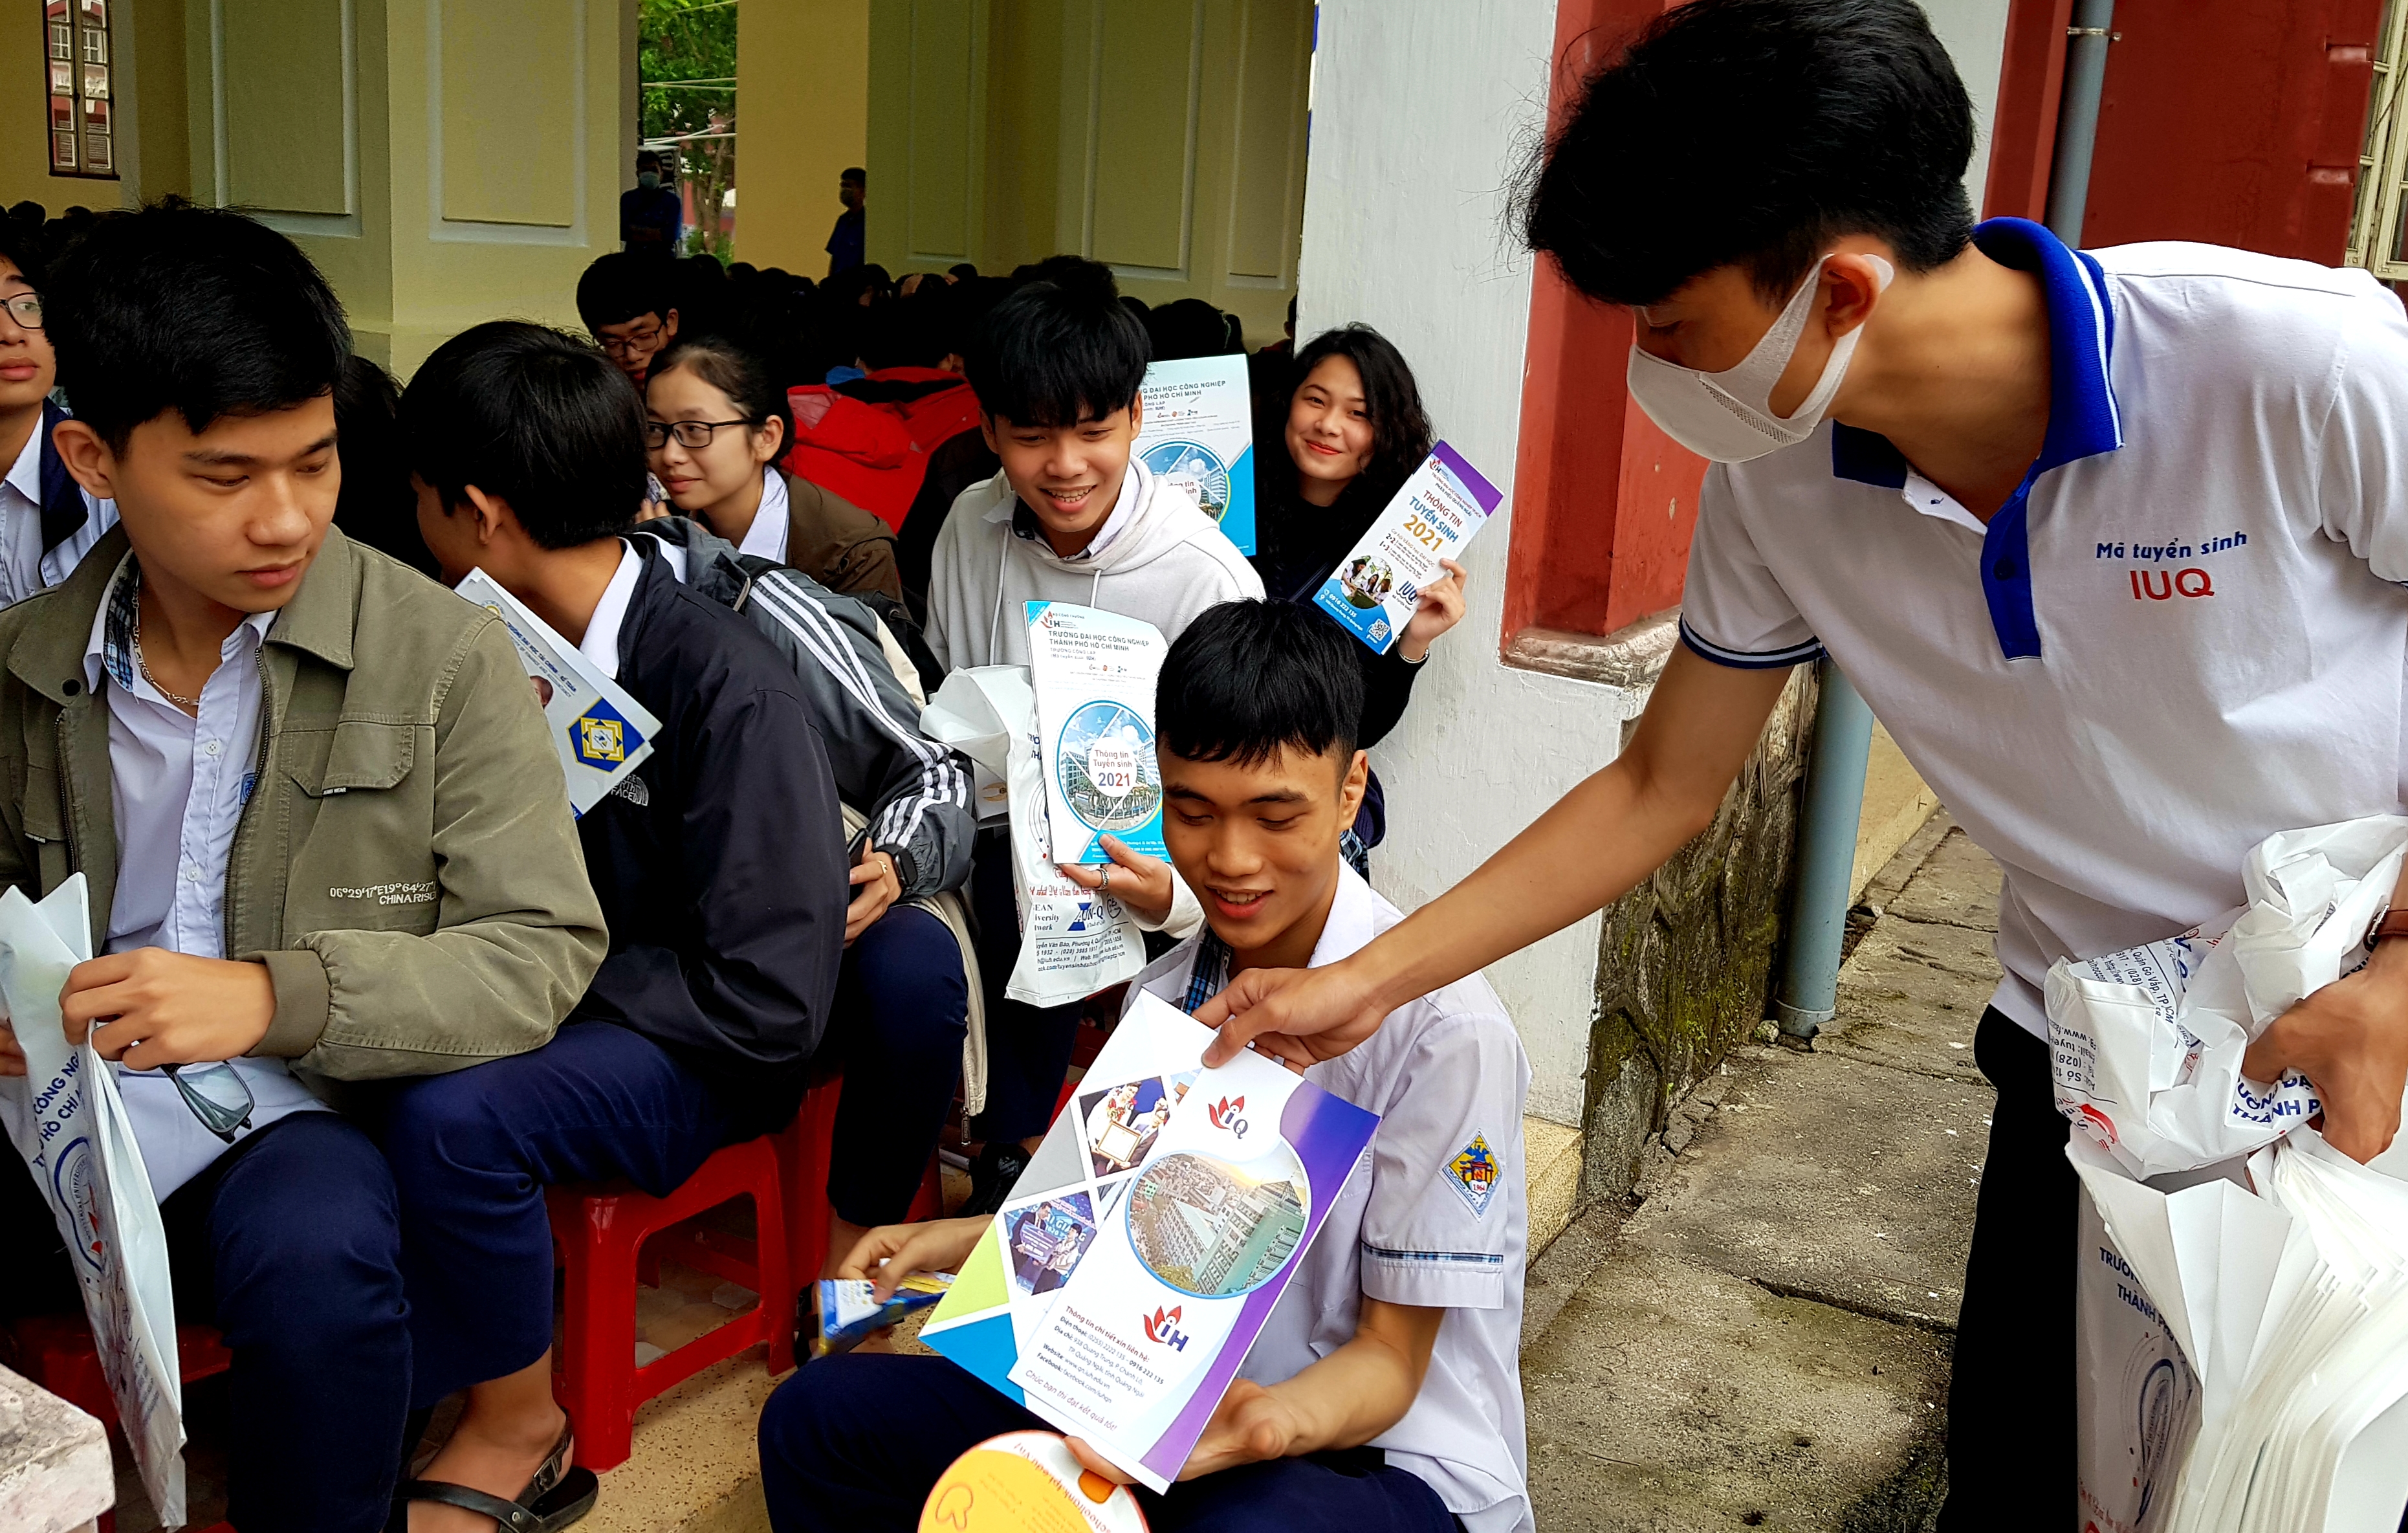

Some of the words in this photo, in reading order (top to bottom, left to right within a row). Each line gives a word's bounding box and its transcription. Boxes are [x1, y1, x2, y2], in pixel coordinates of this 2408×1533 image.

[1423, 490, 1450, 516] THÔNG
[1449, 513, 1463, 527] TIN
[1403, 514, 1443, 552] 2021
[1436, 522, 1459, 543] SINH
[2096, 542, 2125, 558] Mã
[2132, 537, 2192, 563] tuyển
[2200, 531, 2248, 555] sinh
[2130, 568, 2215, 601] IUQ
[1049, 630, 1078, 639] TRƯỜNG
[1108, 635, 1126, 643] CÔNG
[1127, 638, 1150, 646] NGHIỆP
[1049, 638, 1073, 646] THÀNH
[1093, 758, 1115, 769] Tuyển
[1095, 749, 1118, 760] Thông
[1099, 772, 1130, 786] 2021
[2124, 968, 2143, 987] (028)
[2056, 1050, 2081, 1068] (028)
[2066, 1070, 2082, 1082] Số
[2308, 1099, 2321, 1114] P
[2117, 1283, 2157, 1323] THÀNH
[1066, 1305, 1086, 1323] Thông
[1085, 1319, 1095, 1328] tin
[1095, 1326, 1106, 1334] chi
[1104, 1331, 1117, 1341] tiết
[1126, 1344, 1139, 1356] liên
[1036, 1352, 1063, 1373] Facebook:
[1102, 1343, 1116, 1354] 2222
[1116, 1351, 1126, 1360] 135
[1129, 1360, 1143, 1371] 0916
[1143, 1369, 1154, 1378] 222
[1154, 1375, 1165, 1385] 135
[1025, 1369, 1044, 1385] Chúc
[1043, 1382, 1058, 1393] bạn
[1066, 1397, 1080, 1408] đạt
[1078, 1404, 1091, 1415] kết
[1089, 1412, 1105, 1424] quả
